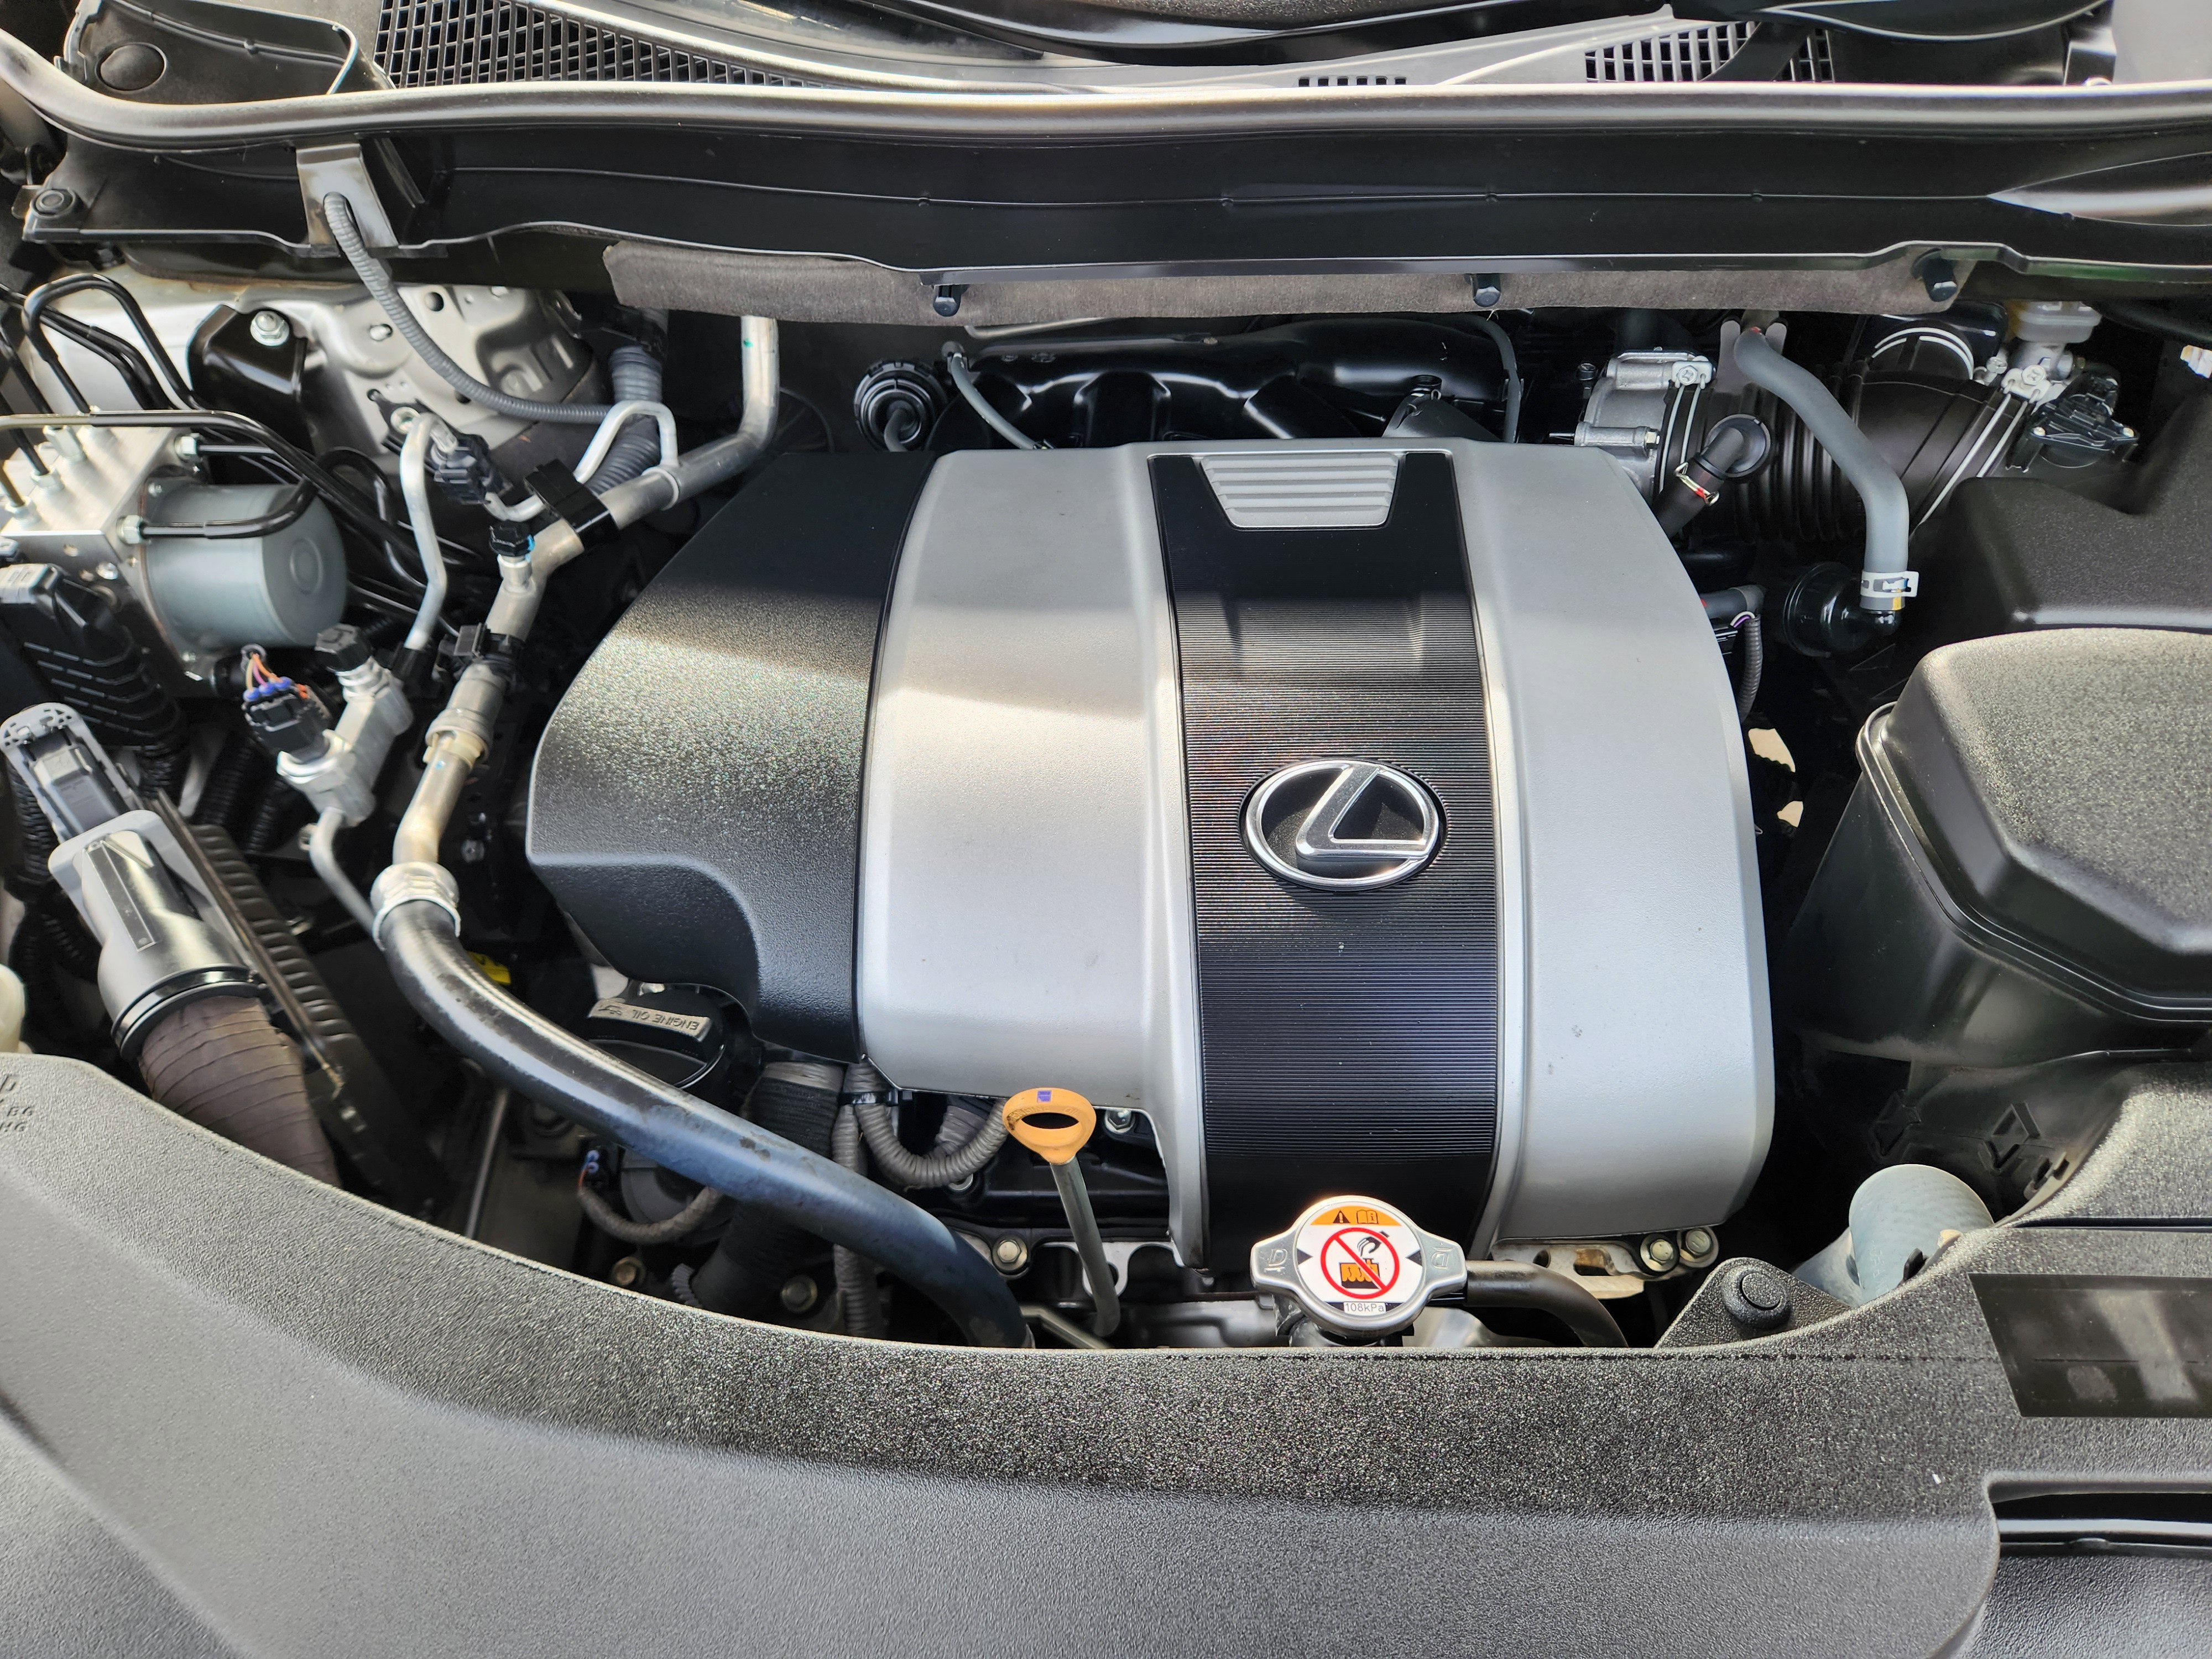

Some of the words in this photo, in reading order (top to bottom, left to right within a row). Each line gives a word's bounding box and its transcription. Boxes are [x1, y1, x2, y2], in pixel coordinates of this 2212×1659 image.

[632, 1009, 650, 1020] OIL
[652, 1013, 700, 1030] ENGINE
[1009, 1105, 1050, 1120] ENGINE
[1345, 1303, 1385, 1312] 108kPa
